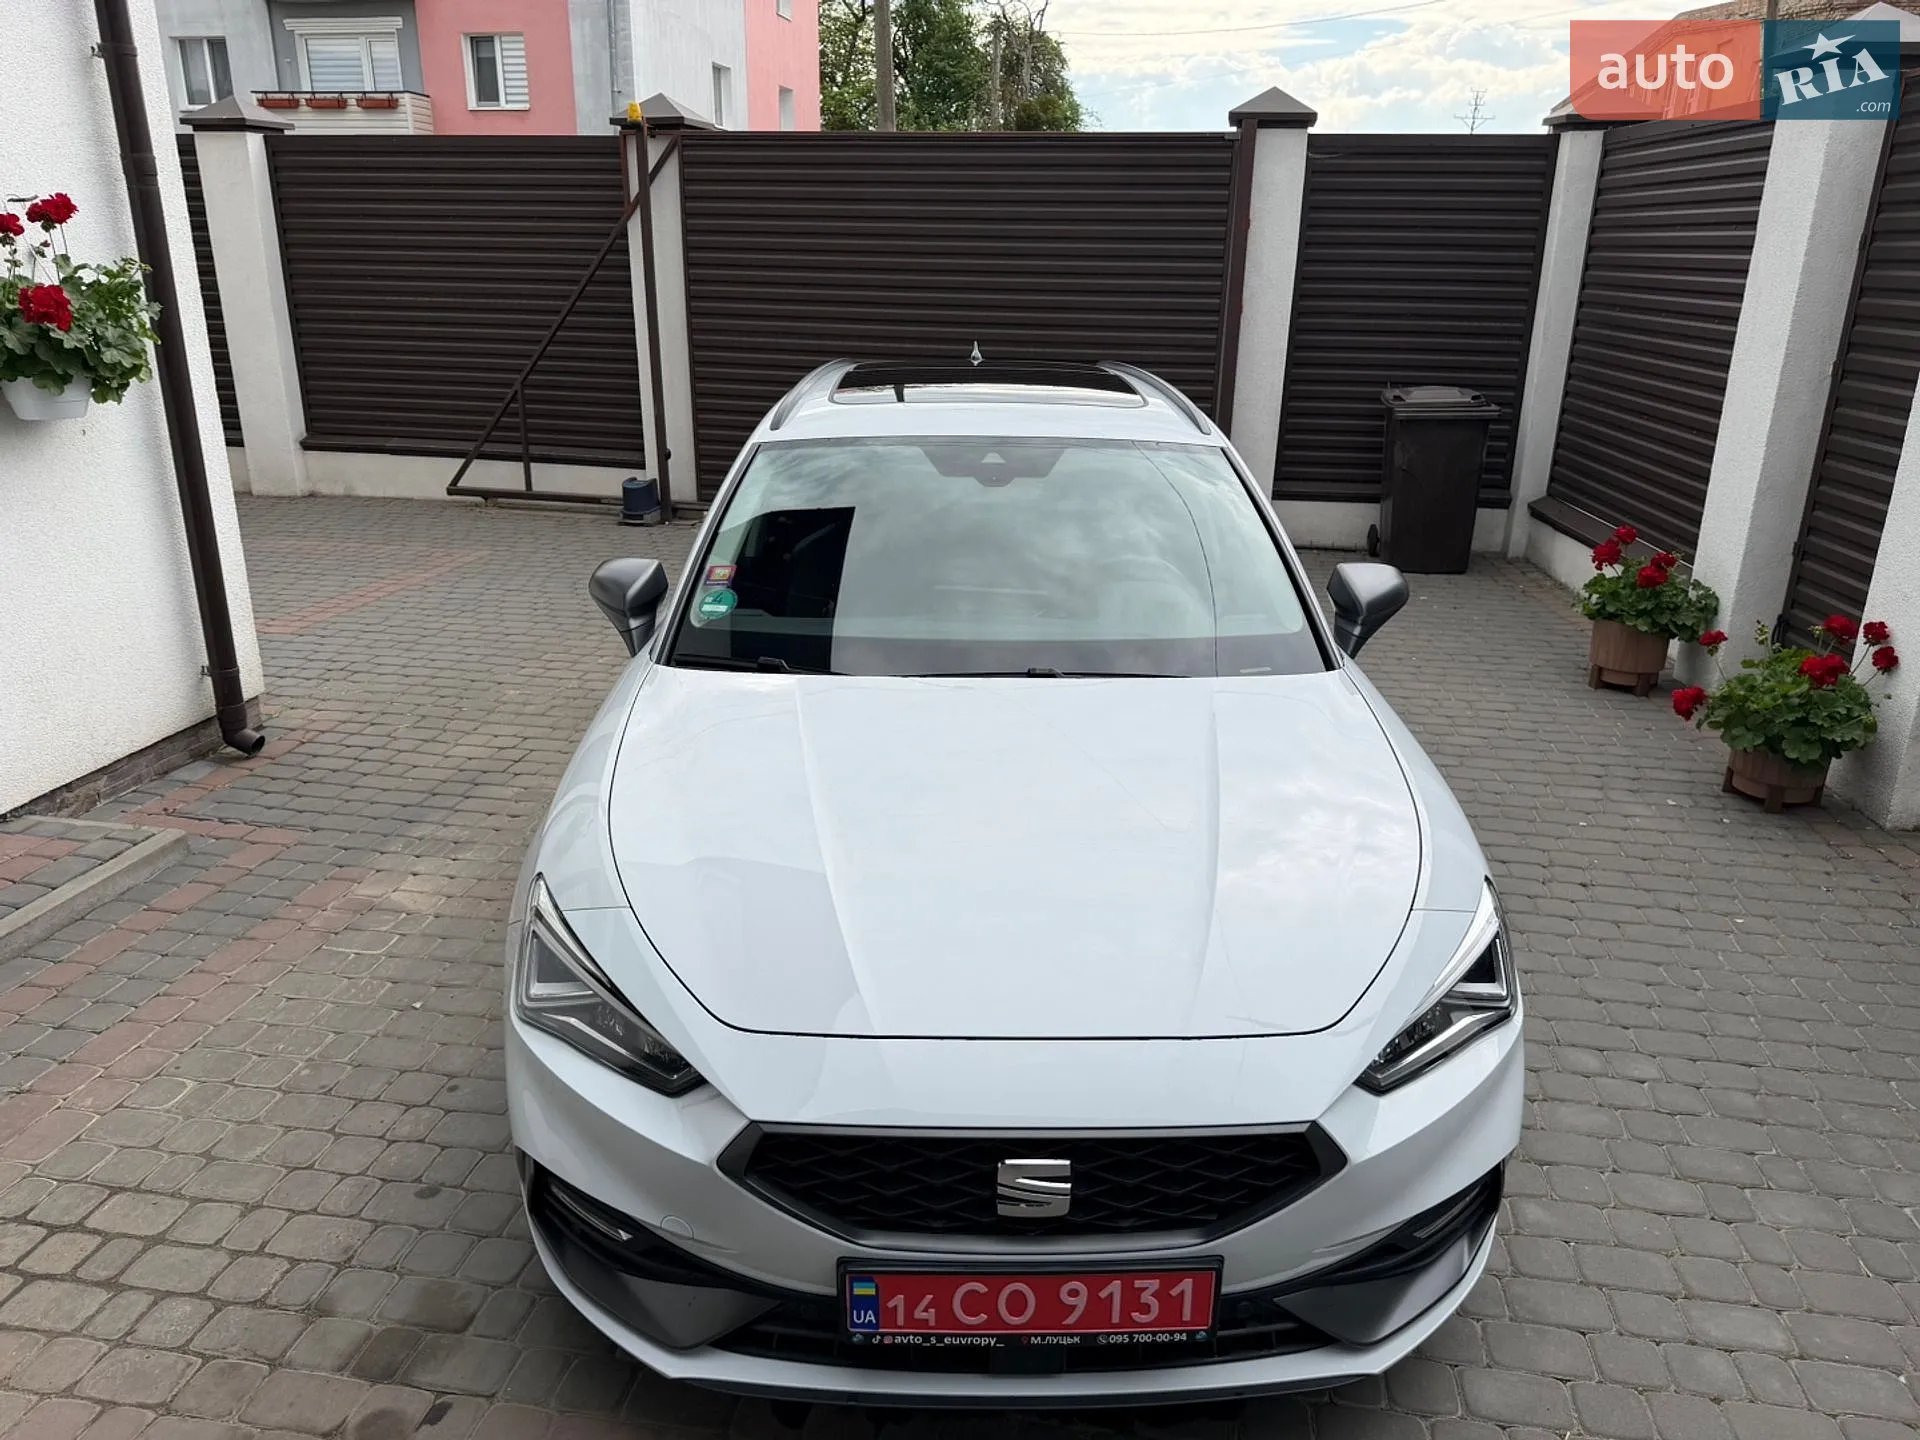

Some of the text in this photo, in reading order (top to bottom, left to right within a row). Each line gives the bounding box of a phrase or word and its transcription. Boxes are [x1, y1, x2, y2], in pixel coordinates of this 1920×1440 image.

[886, 1294, 936, 1327] 14
[1059, 1278, 1194, 1325] 9131
[852, 1309, 877, 1324] UA
[1109, 1332, 1188, 1344] 095 700-00-94
